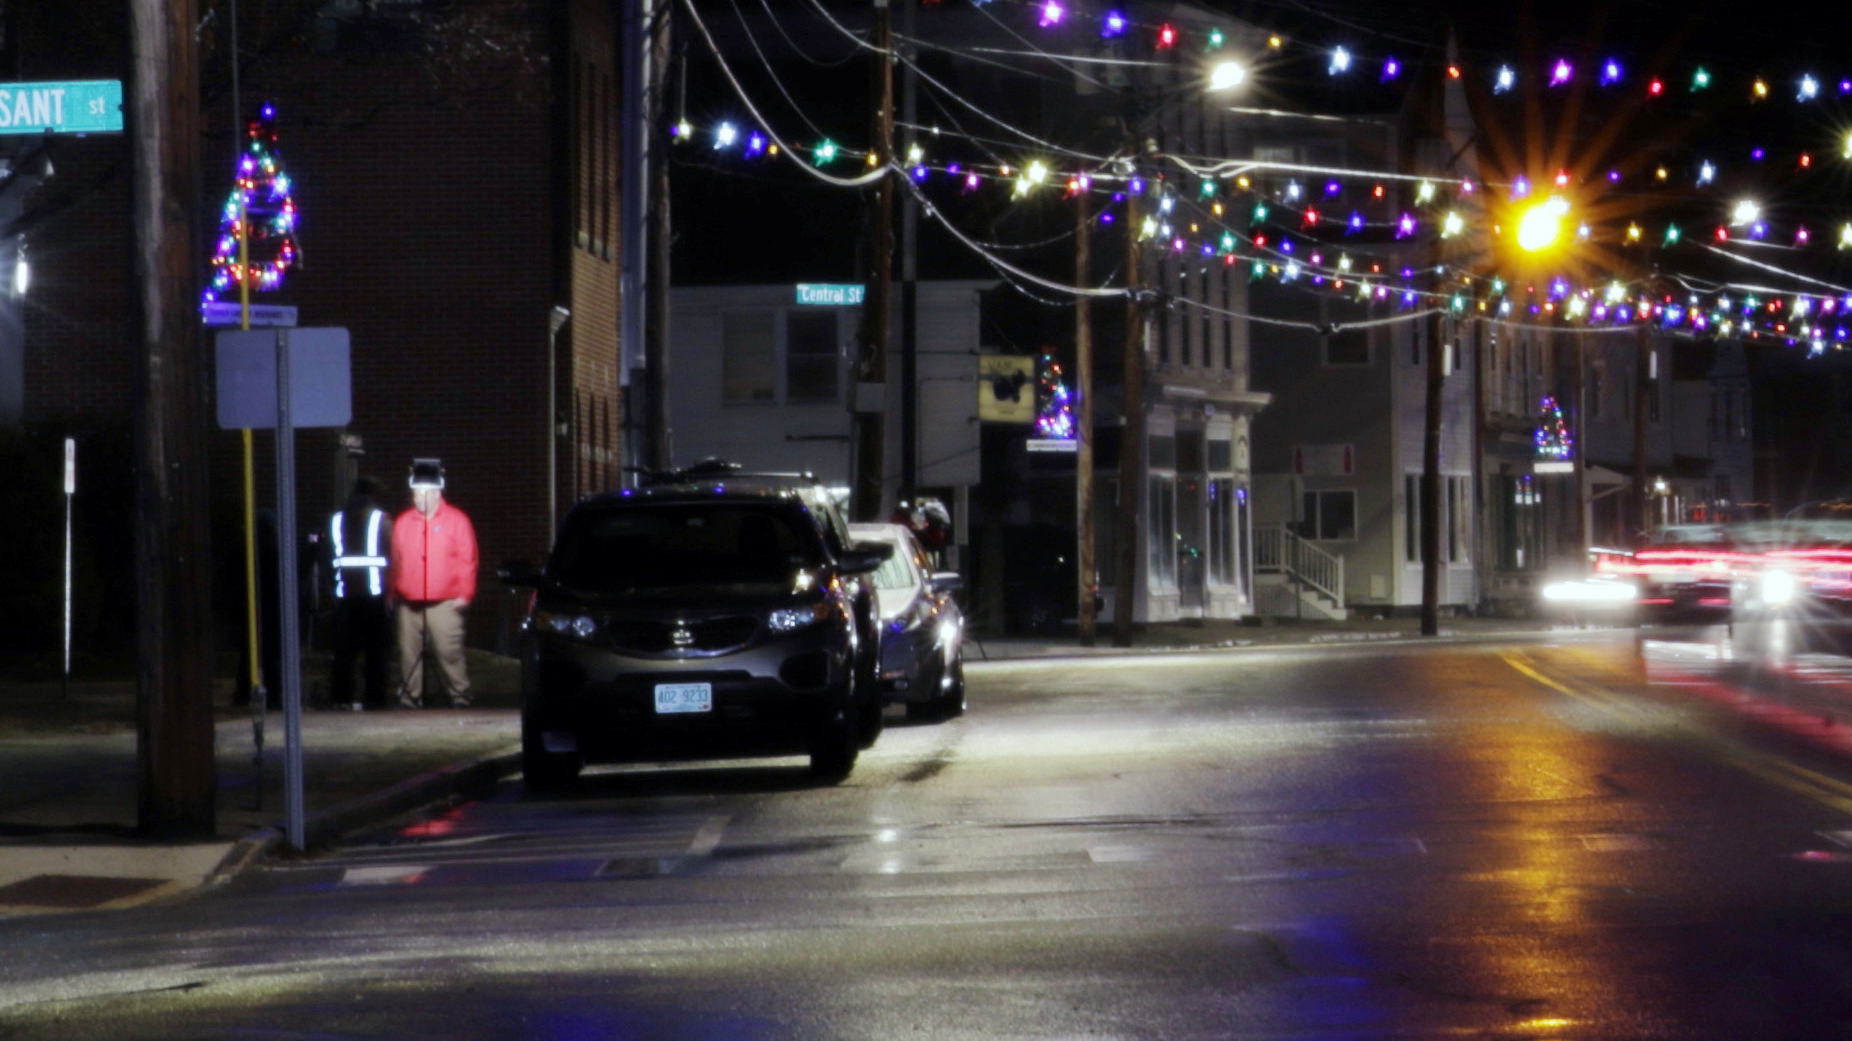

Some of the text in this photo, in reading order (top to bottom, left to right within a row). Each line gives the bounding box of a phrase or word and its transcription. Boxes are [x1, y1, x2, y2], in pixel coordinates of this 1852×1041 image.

[0, 89, 106, 127] SANT st
[802, 287, 861, 303] Central St
